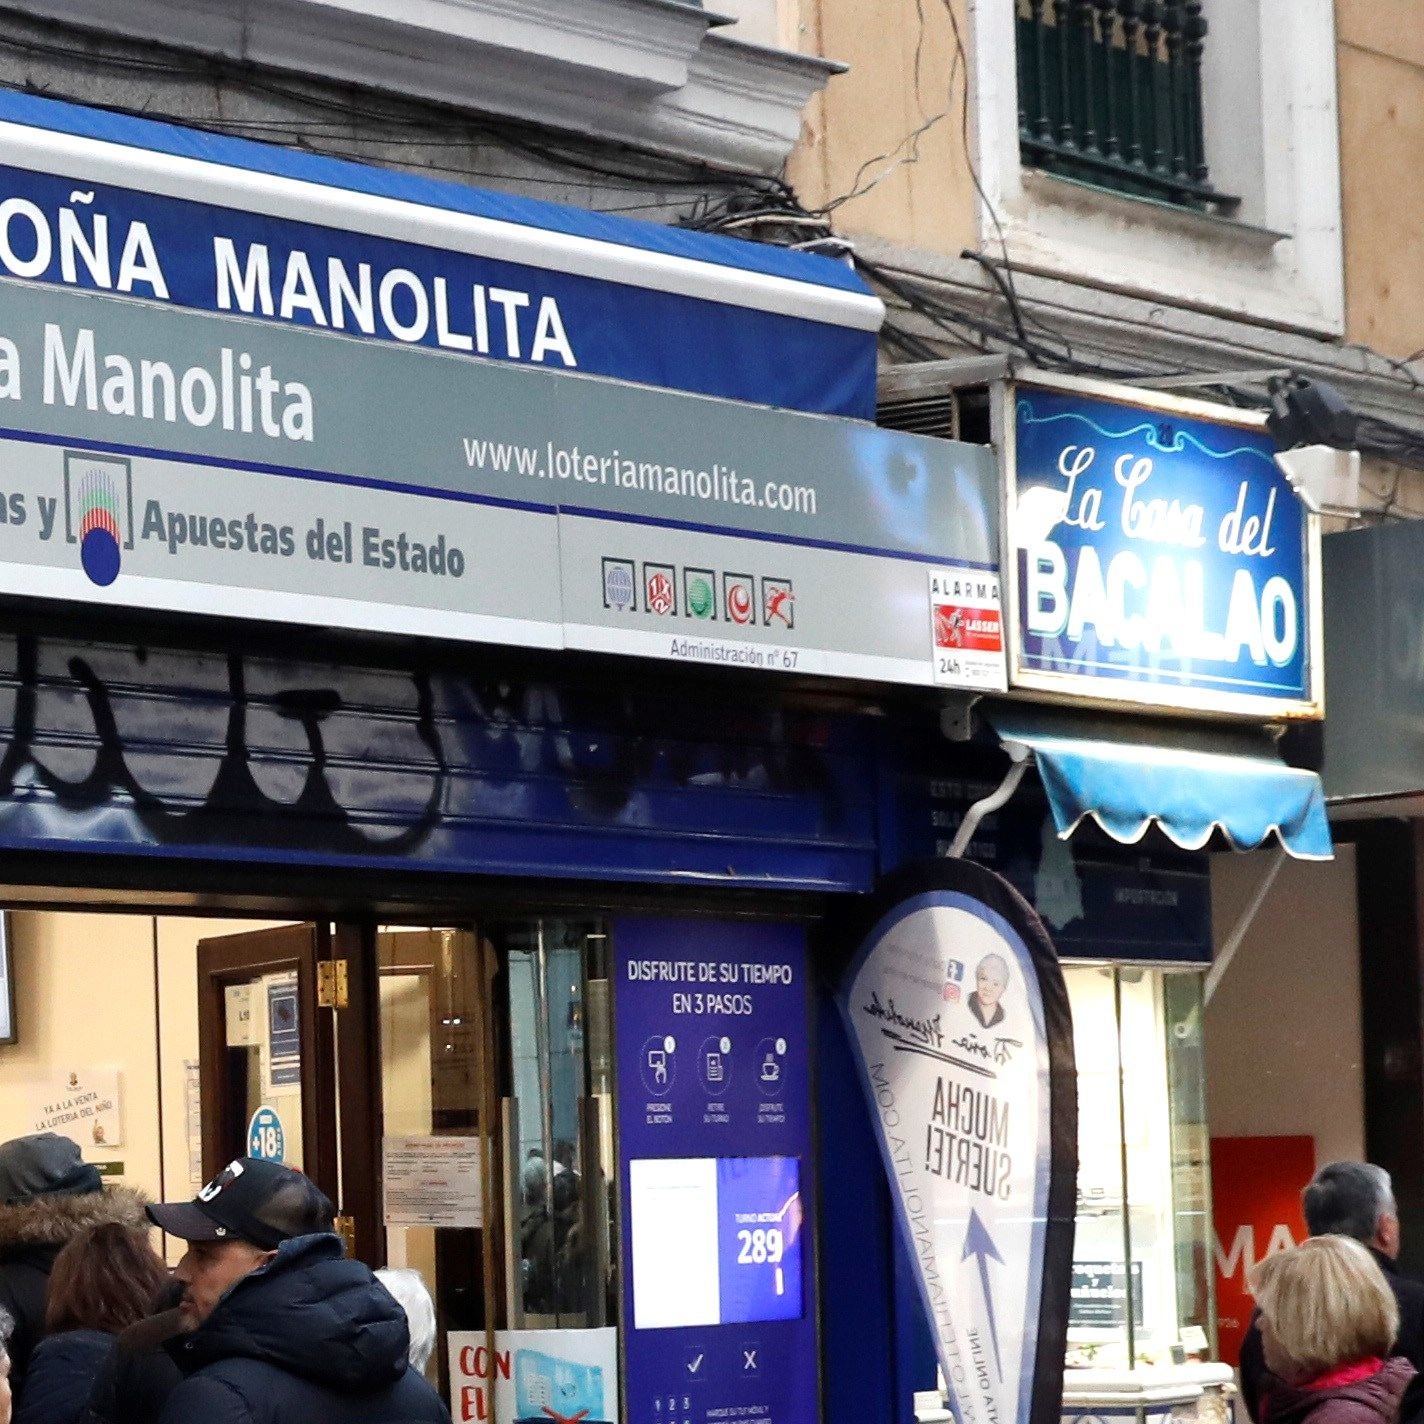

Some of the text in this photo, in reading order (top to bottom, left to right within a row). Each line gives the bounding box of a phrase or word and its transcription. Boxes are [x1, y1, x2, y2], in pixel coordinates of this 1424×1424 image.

[212, 236, 578, 368] MANOLITA
[42, 321, 315, 442] Manolita
[462, 436, 818, 516] www.loteriamanolita.com
[1218, 481, 1277, 557] del
[36, 497, 58, 540] y
[141, 499, 295, 558] Apuestas
[306, 518, 354, 565] del
[362, 527, 465, 579] Estado
[931, 578, 1000, 600] ALARMA
[1028, 541, 1297, 668] BACALAO
[670, 639, 762, 666] Administración
[783, 651, 798, 668] 67
[628, 961, 793, 985] DISFRUTE DE SU TIEMPO
[673, 994, 753, 1015] EN 3 PASOS
[737, 1229, 783, 1264] 289
[459, 1345, 511, 1380] CON
[461, 1386, 488, 1422] EL
